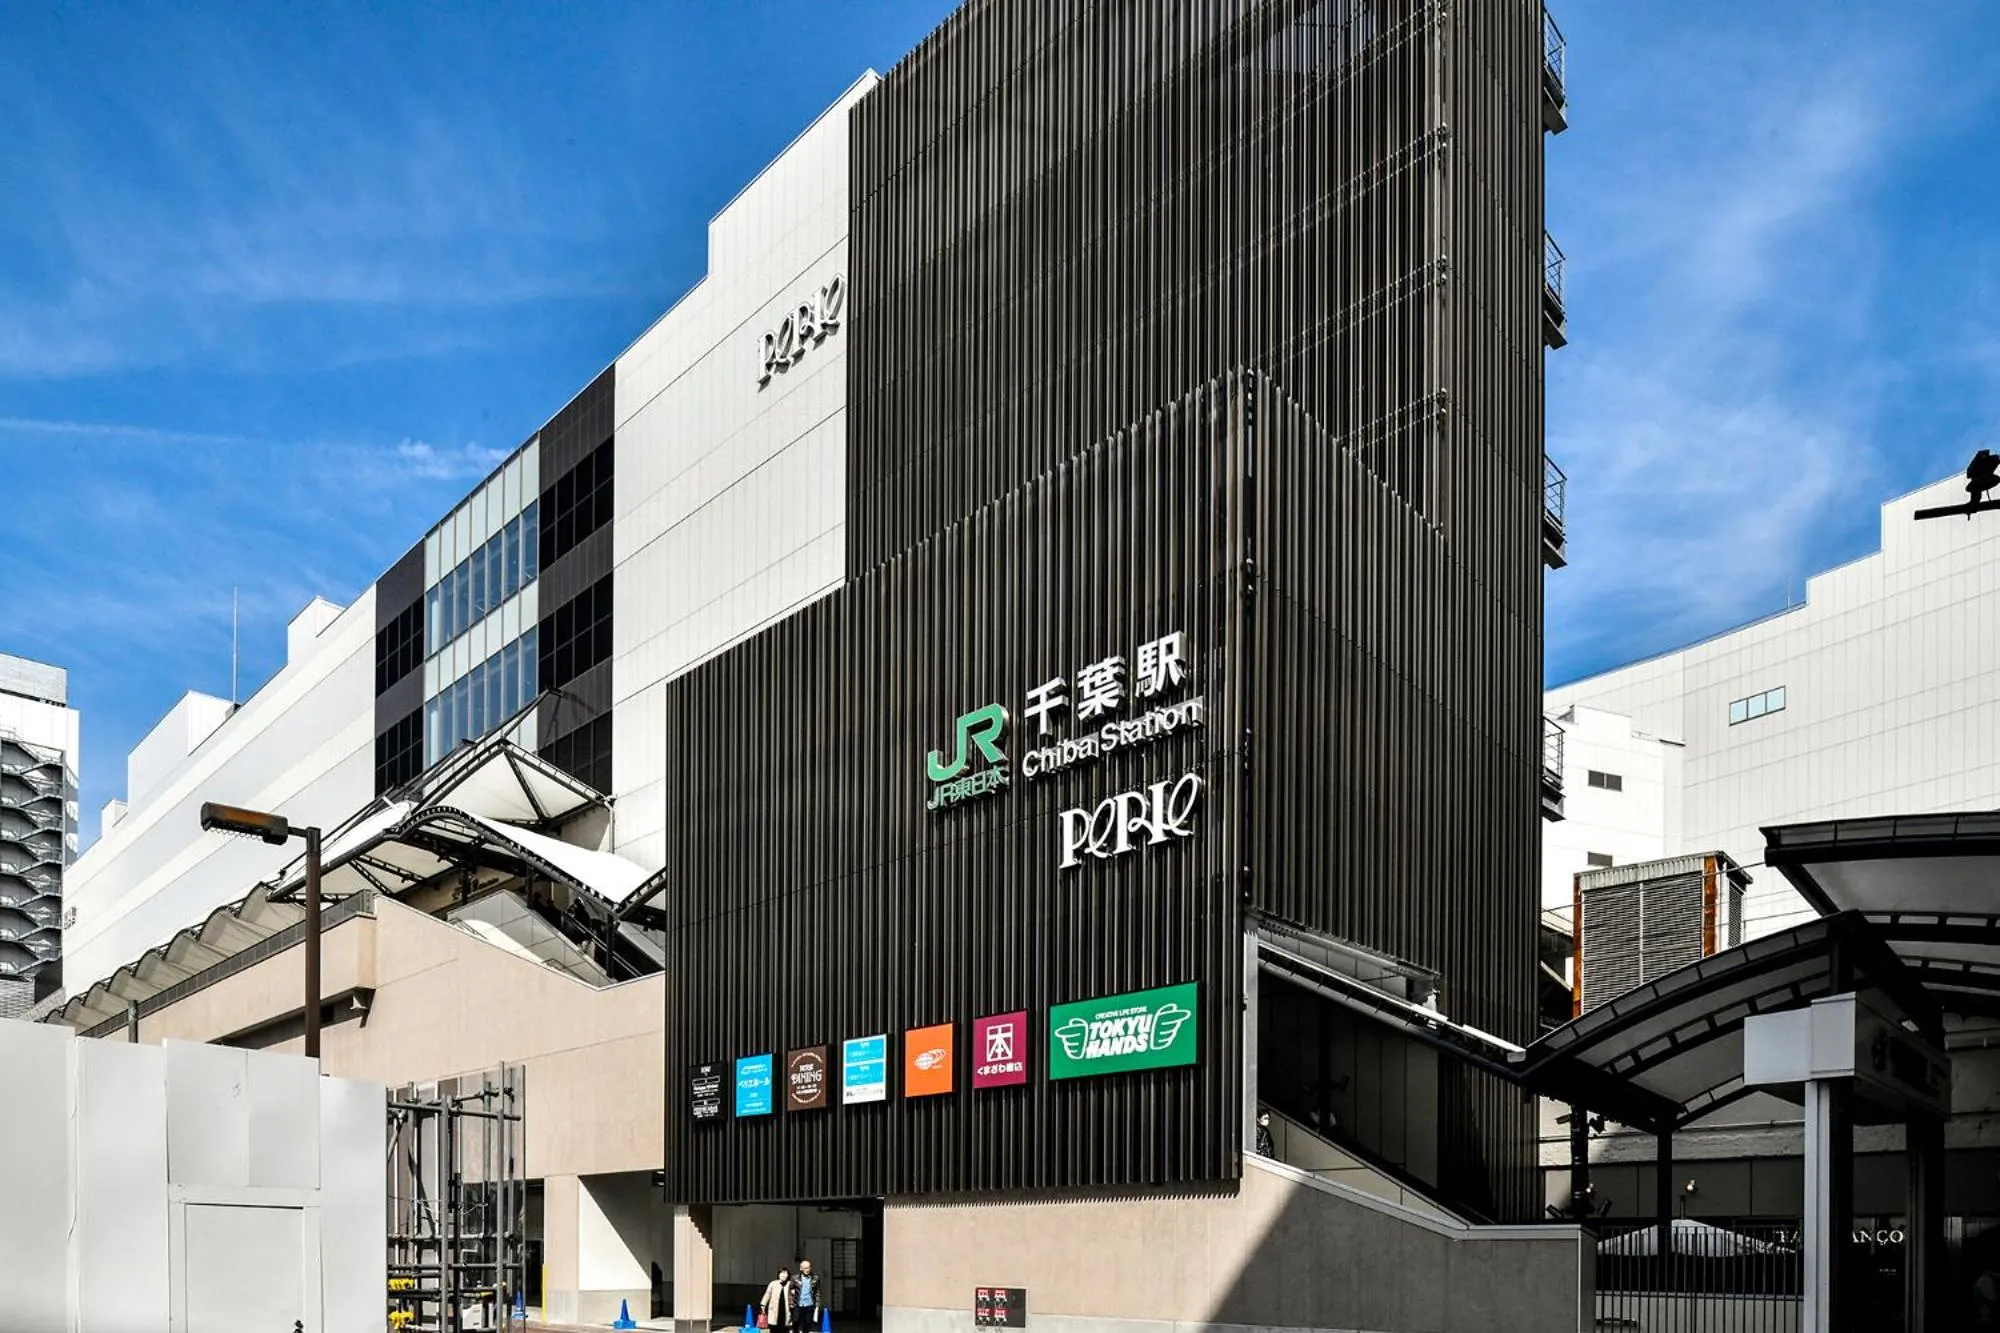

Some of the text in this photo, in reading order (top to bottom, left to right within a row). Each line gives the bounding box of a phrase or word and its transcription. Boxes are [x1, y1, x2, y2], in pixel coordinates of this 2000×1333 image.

[1024, 631, 1187, 736] 千葉駅
[927, 703, 1009, 781] JR
[1023, 696, 1204, 778] Chiba Station
[927, 766, 1010, 811] JR東日本
[1086, 1033, 1149, 1059] HANDS
[1089, 1014, 1153, 1040] TOKYU
[790, 1069, 823, 1085] DINING
